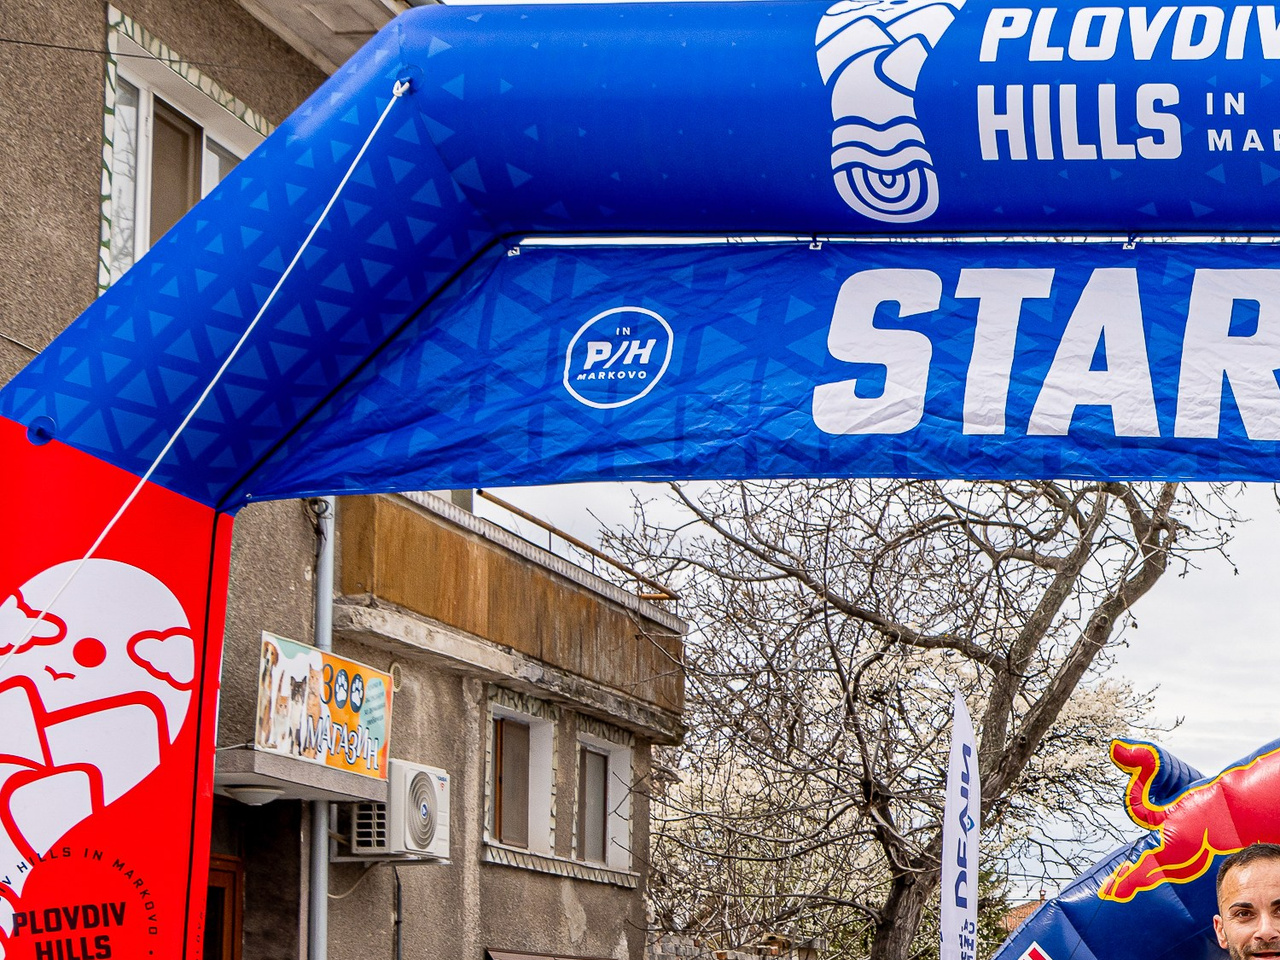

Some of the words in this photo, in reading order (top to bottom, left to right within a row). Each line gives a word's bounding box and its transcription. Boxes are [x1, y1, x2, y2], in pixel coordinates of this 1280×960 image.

[1206, 92, 1246, 116] IN
[977, 83, 1184, 161] HILLS
[615, 326, 630, 337] IN
[582, 338, 655, 368] P/H
[576, 370, 647, 381] MARKOVO
[306, 714, 379, 771] МАГАЗИН
[17, 847, 71, 873] HILLS
[83, 848, 103, 861] IN
[112, 858, 158, 935] MARKOVO
[12, 901, 126, 937] PLOVDIV
